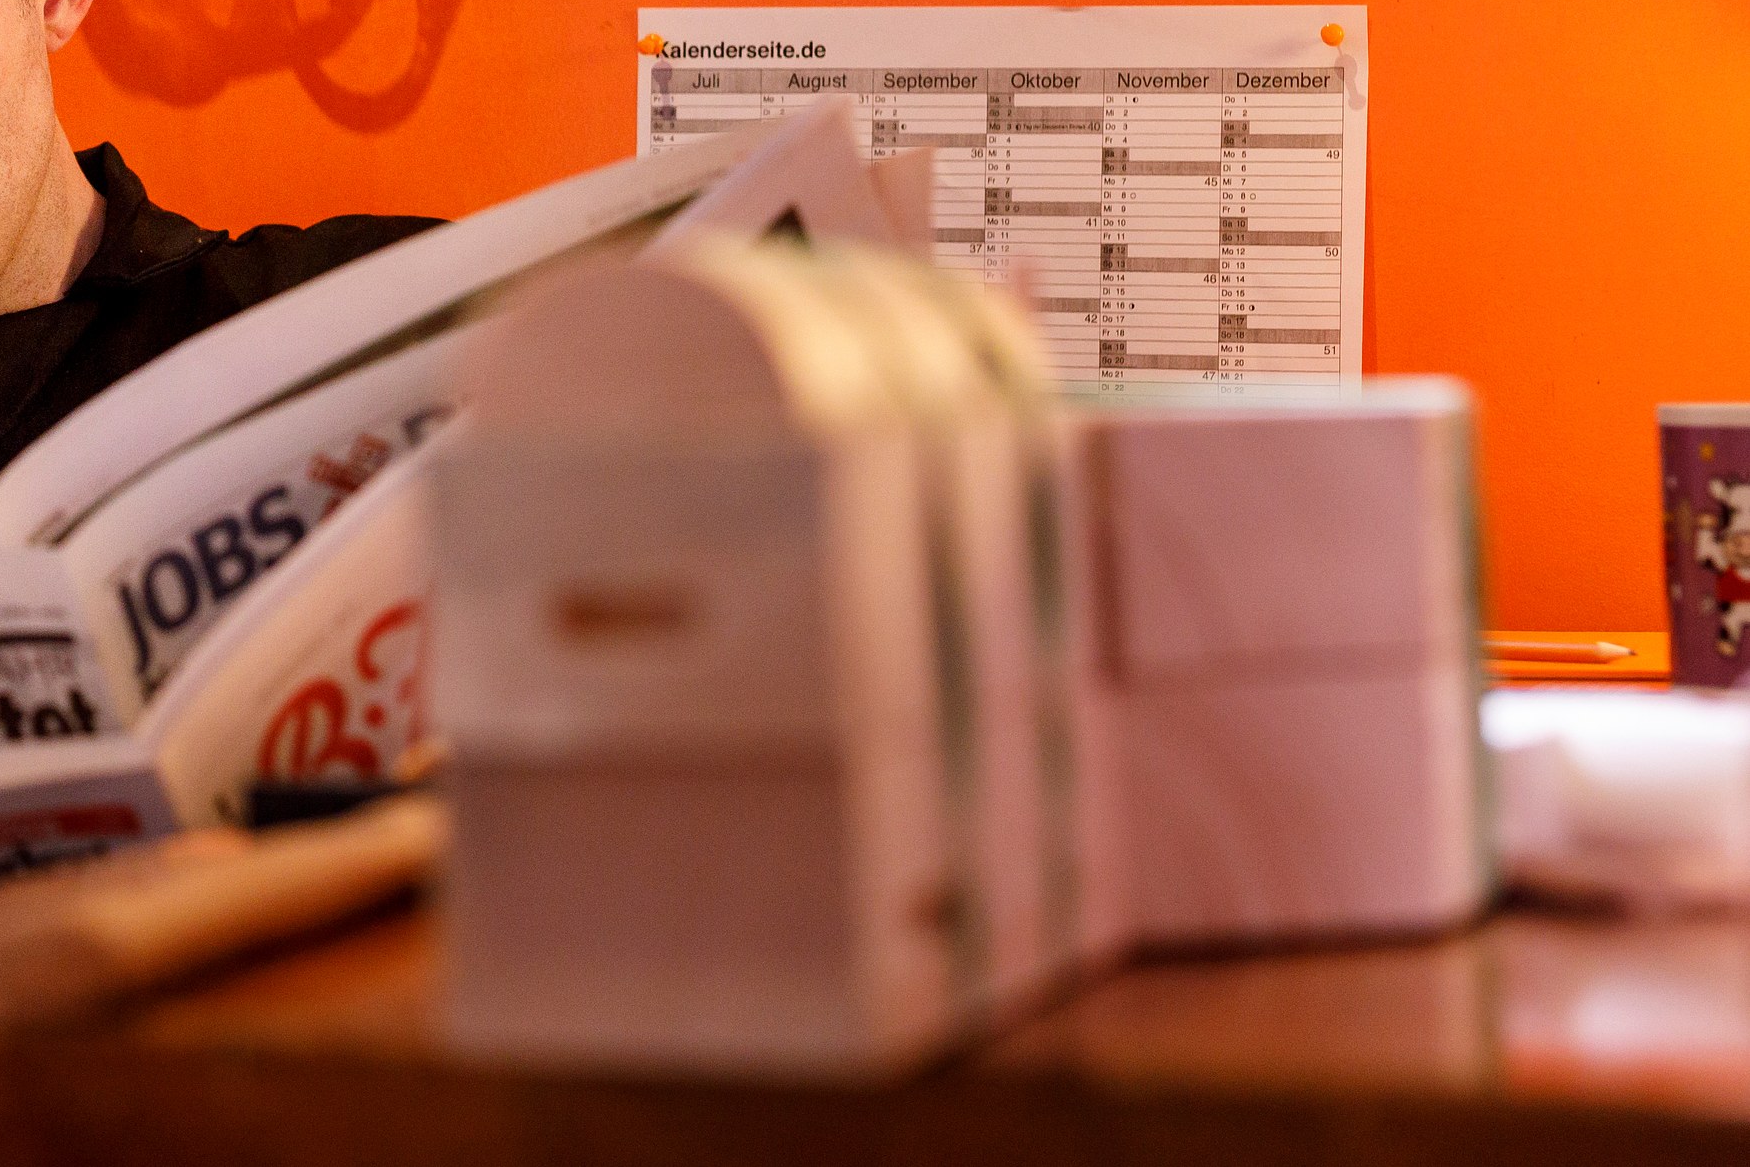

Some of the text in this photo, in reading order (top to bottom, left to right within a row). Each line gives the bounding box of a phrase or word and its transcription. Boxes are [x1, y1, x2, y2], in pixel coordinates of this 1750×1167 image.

[656, 41, 826, 59] Kalenderseite.de
[692, 72, 1331, 92] Juli August September Oktober November Dezember
[1088, 122, 1100, 131] 40
[971, 148, 983, 158] 36
[1326, 149, 1340, 160] 49
[1204, 177, 1218, 187] 45
[1086, 217, 1098, 227] 41
[969, 243, 982, 254] 37
[1221, 248, 1234, 256] Mo
[1325, 247, 1339, 258] 50
[1203, 274, 1216, 284] 46
[1221, 275, 1231, 283] Mi
[1084, 313, 1098, 324] 42
[1221, 345, 1233, 353] Mo
[1324, 346, 1337, 357] 51
[1202, 371, 1216, 381] 47
[118, 485, 307, 676] JOBS
